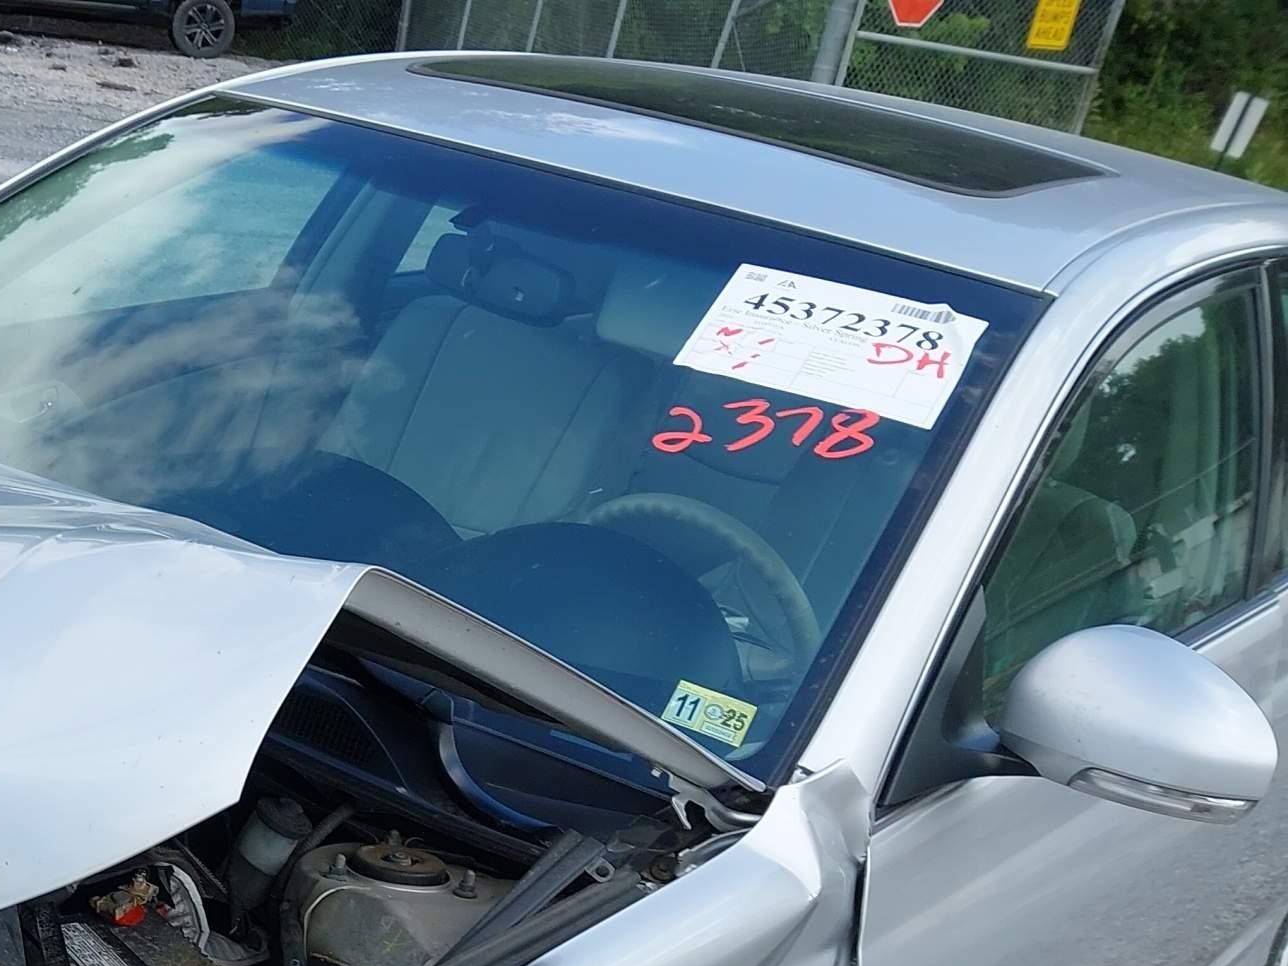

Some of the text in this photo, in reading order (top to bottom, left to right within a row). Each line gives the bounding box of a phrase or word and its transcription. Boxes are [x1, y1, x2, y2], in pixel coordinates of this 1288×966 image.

[744, 292, 945, 351] 45372378
[652, 399, 881, 459] 2378
[675, 694, 701, 721] 11
[720, 708, 748, 731] 25
